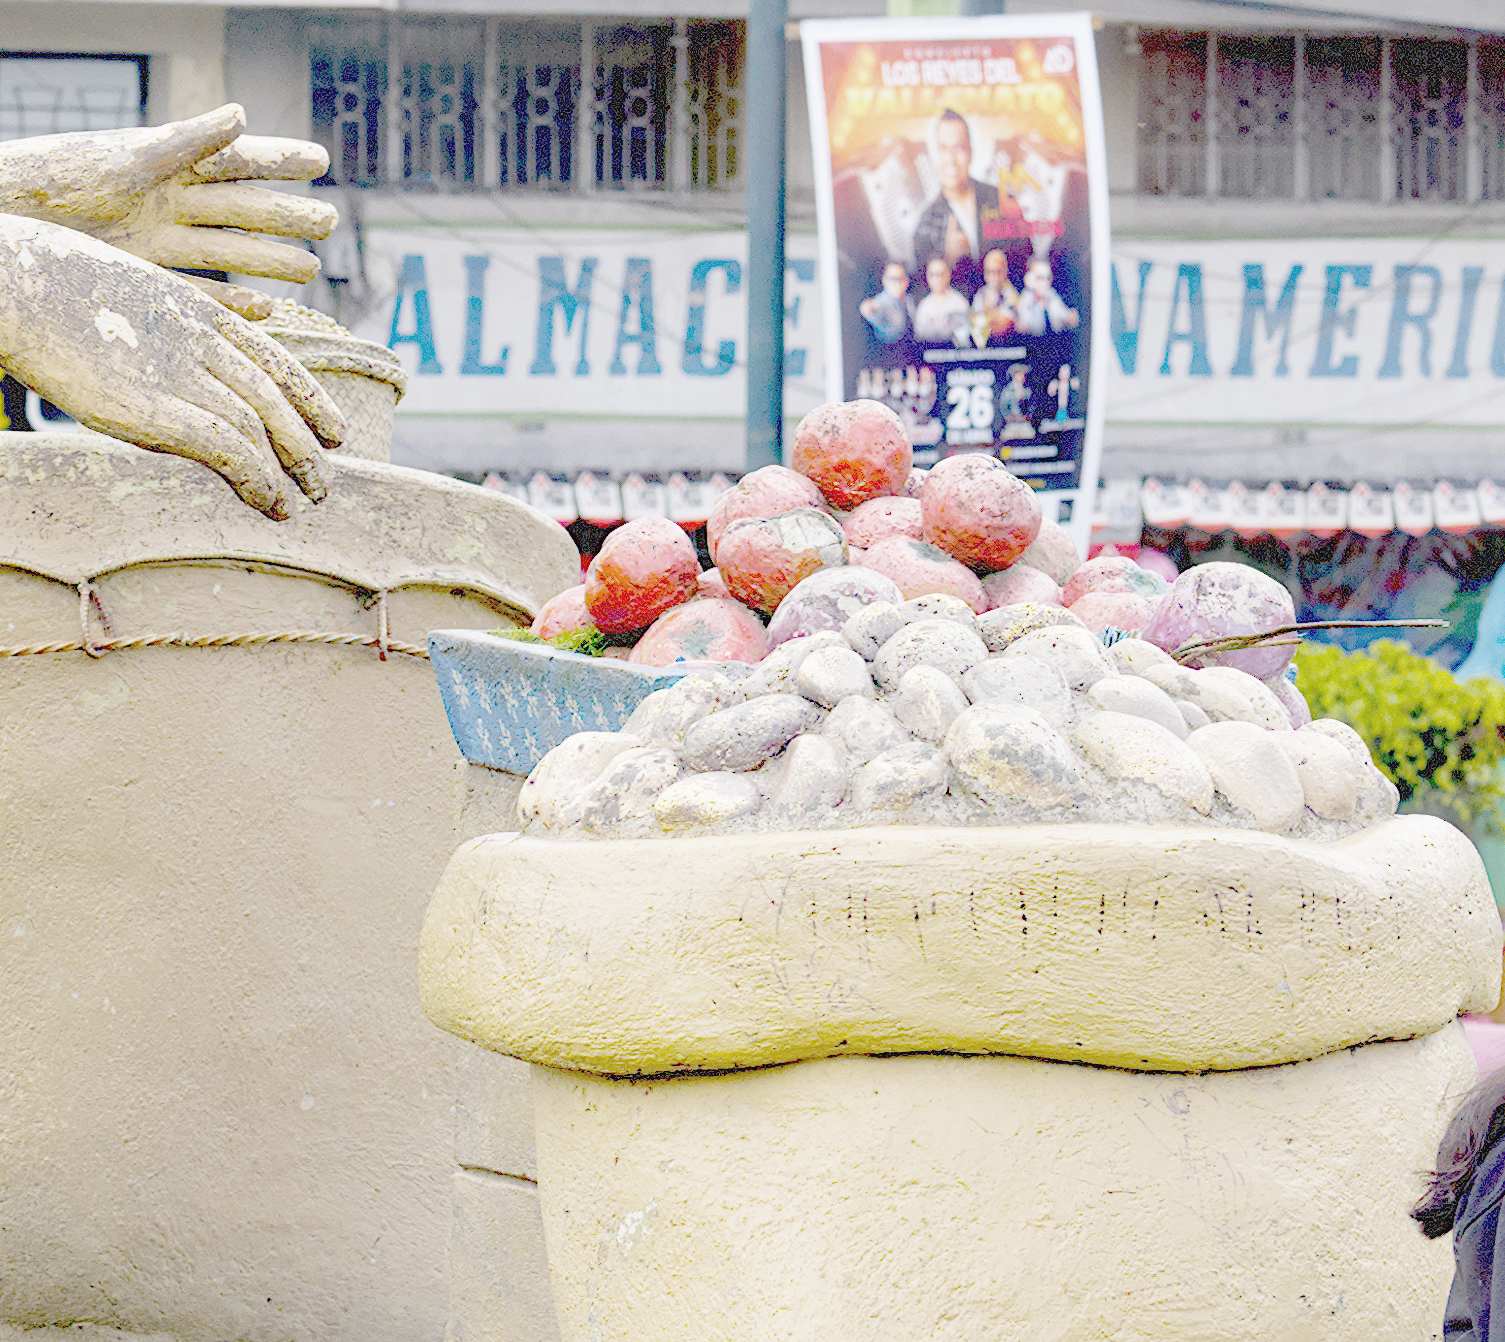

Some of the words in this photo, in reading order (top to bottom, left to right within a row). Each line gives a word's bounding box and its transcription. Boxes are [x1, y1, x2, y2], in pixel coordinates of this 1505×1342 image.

[881, 61, 920, 87] LOS
[921, 60, 982, 86] REYES
[983, 58, 1023, 84] DEL
[390, 254, 817, 377] ALMACE
[946, 385, 995, 429] 26
